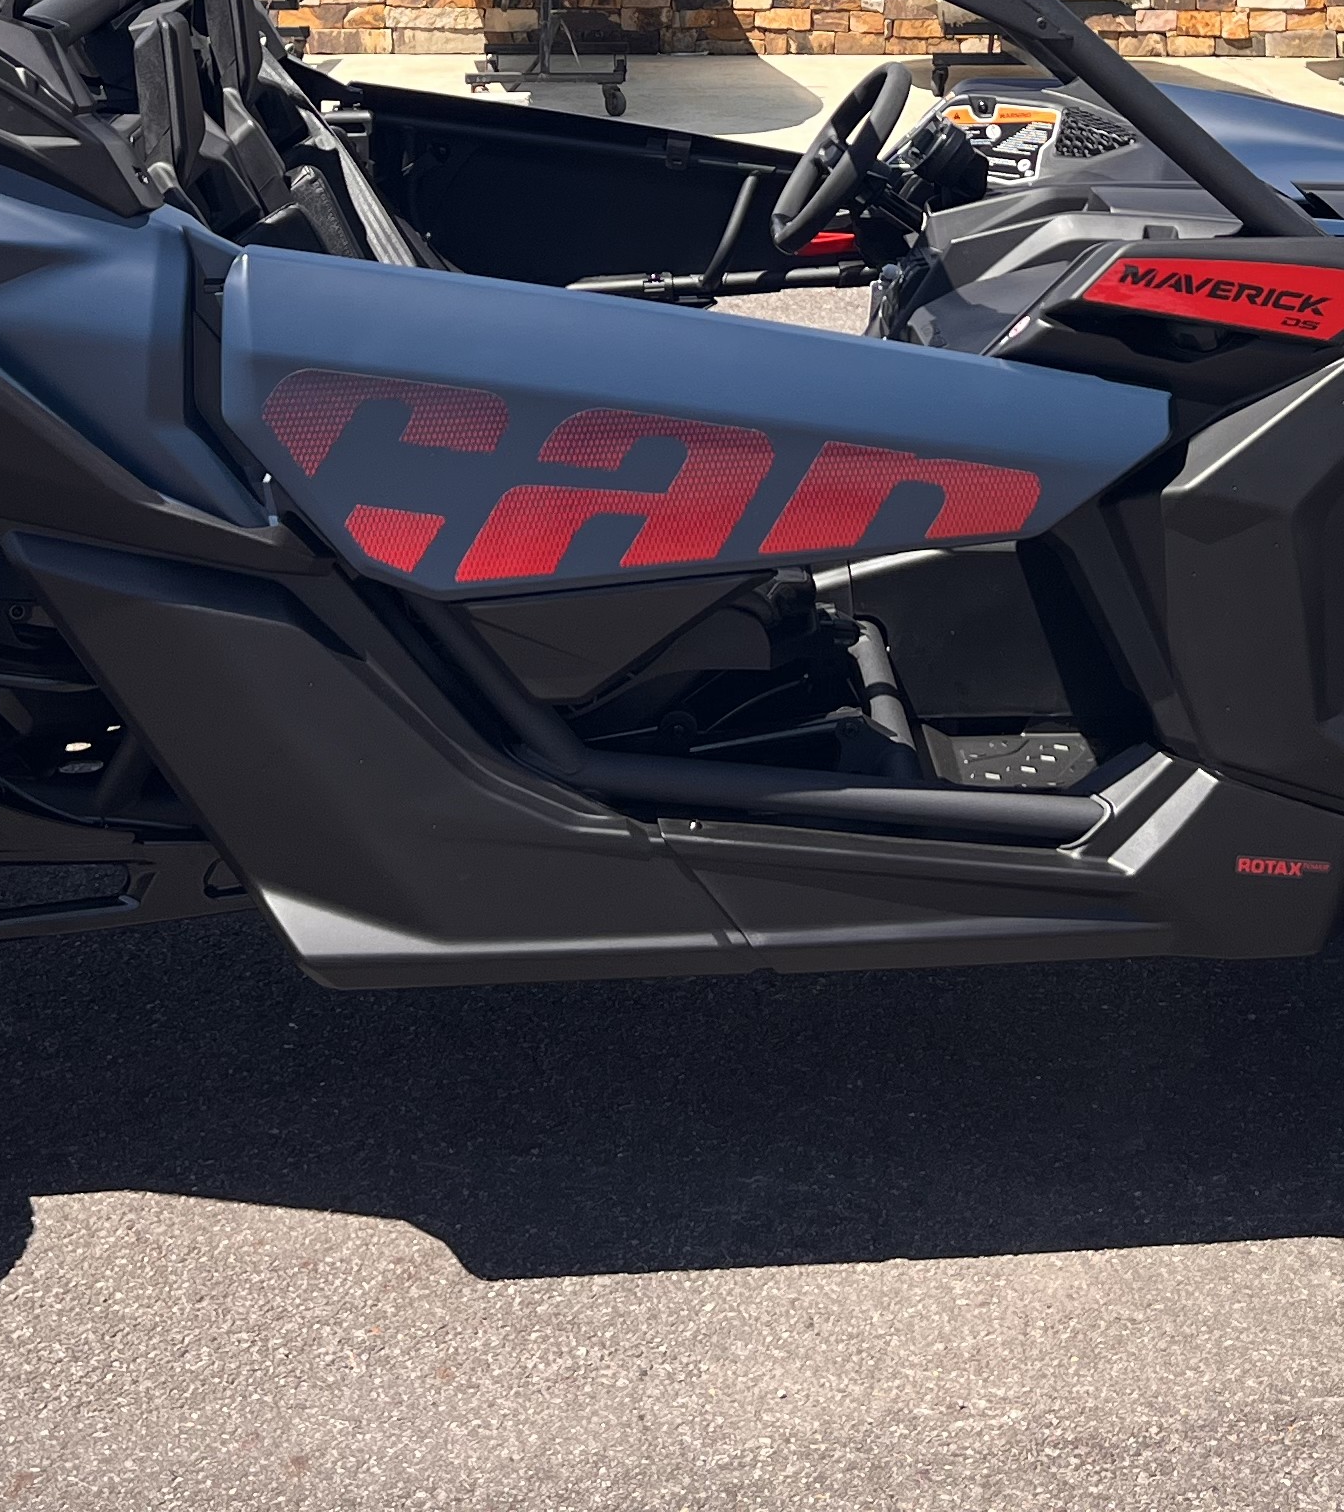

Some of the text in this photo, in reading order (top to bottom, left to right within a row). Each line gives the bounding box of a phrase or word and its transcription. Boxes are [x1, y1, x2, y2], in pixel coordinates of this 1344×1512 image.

[1119, 263, 1334, 317] MAVERICK
[1280, 316, 1321, 332] DS
[261, 367, 1042, 583] can
[1238, 857, 1303, 878] ROTAX
